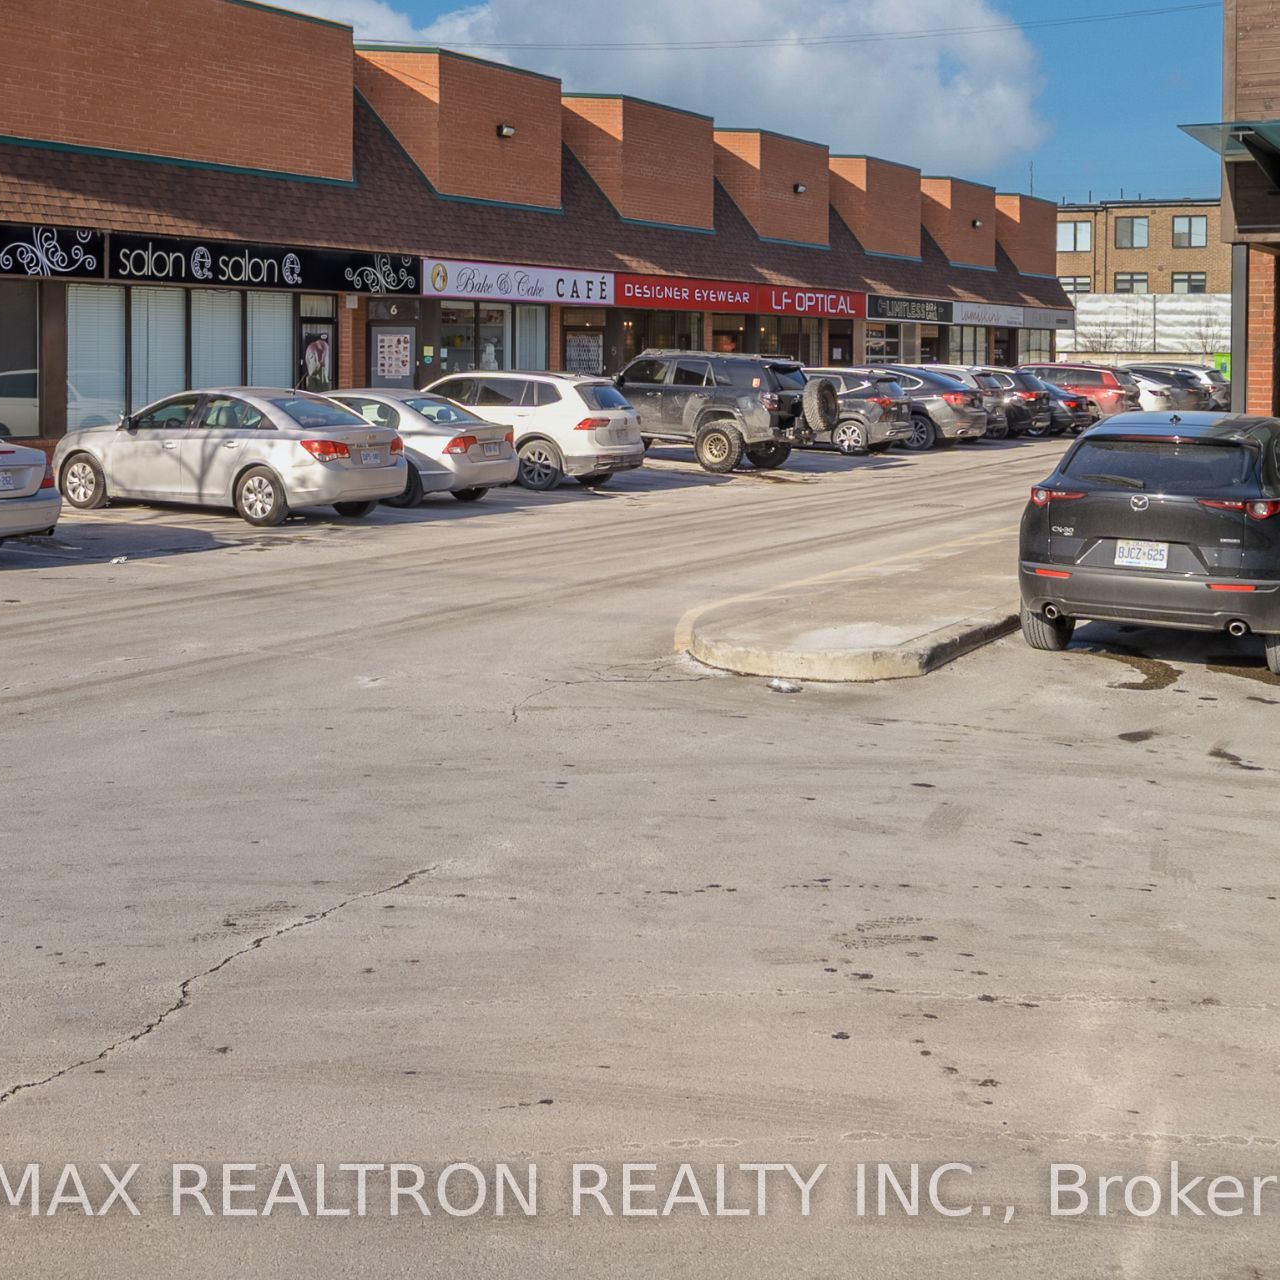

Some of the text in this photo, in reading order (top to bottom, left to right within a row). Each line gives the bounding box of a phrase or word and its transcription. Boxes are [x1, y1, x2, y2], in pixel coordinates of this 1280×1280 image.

[119, 242, 186, 278] salon
[219, 249, 278, 283] salon
[456, 267, 494, 294] Bake
[514, 270, 545, 297] Cake
[556, 276, 608, 300] CAFÉ
[624, 283, 750, 304] DESIGNER EYEWEAR
[390, 305, 398, 315] 6
[772, 291, 856, 314] LF OPTICAL
[1118, 546, 1165, 561] BJCZ 625
